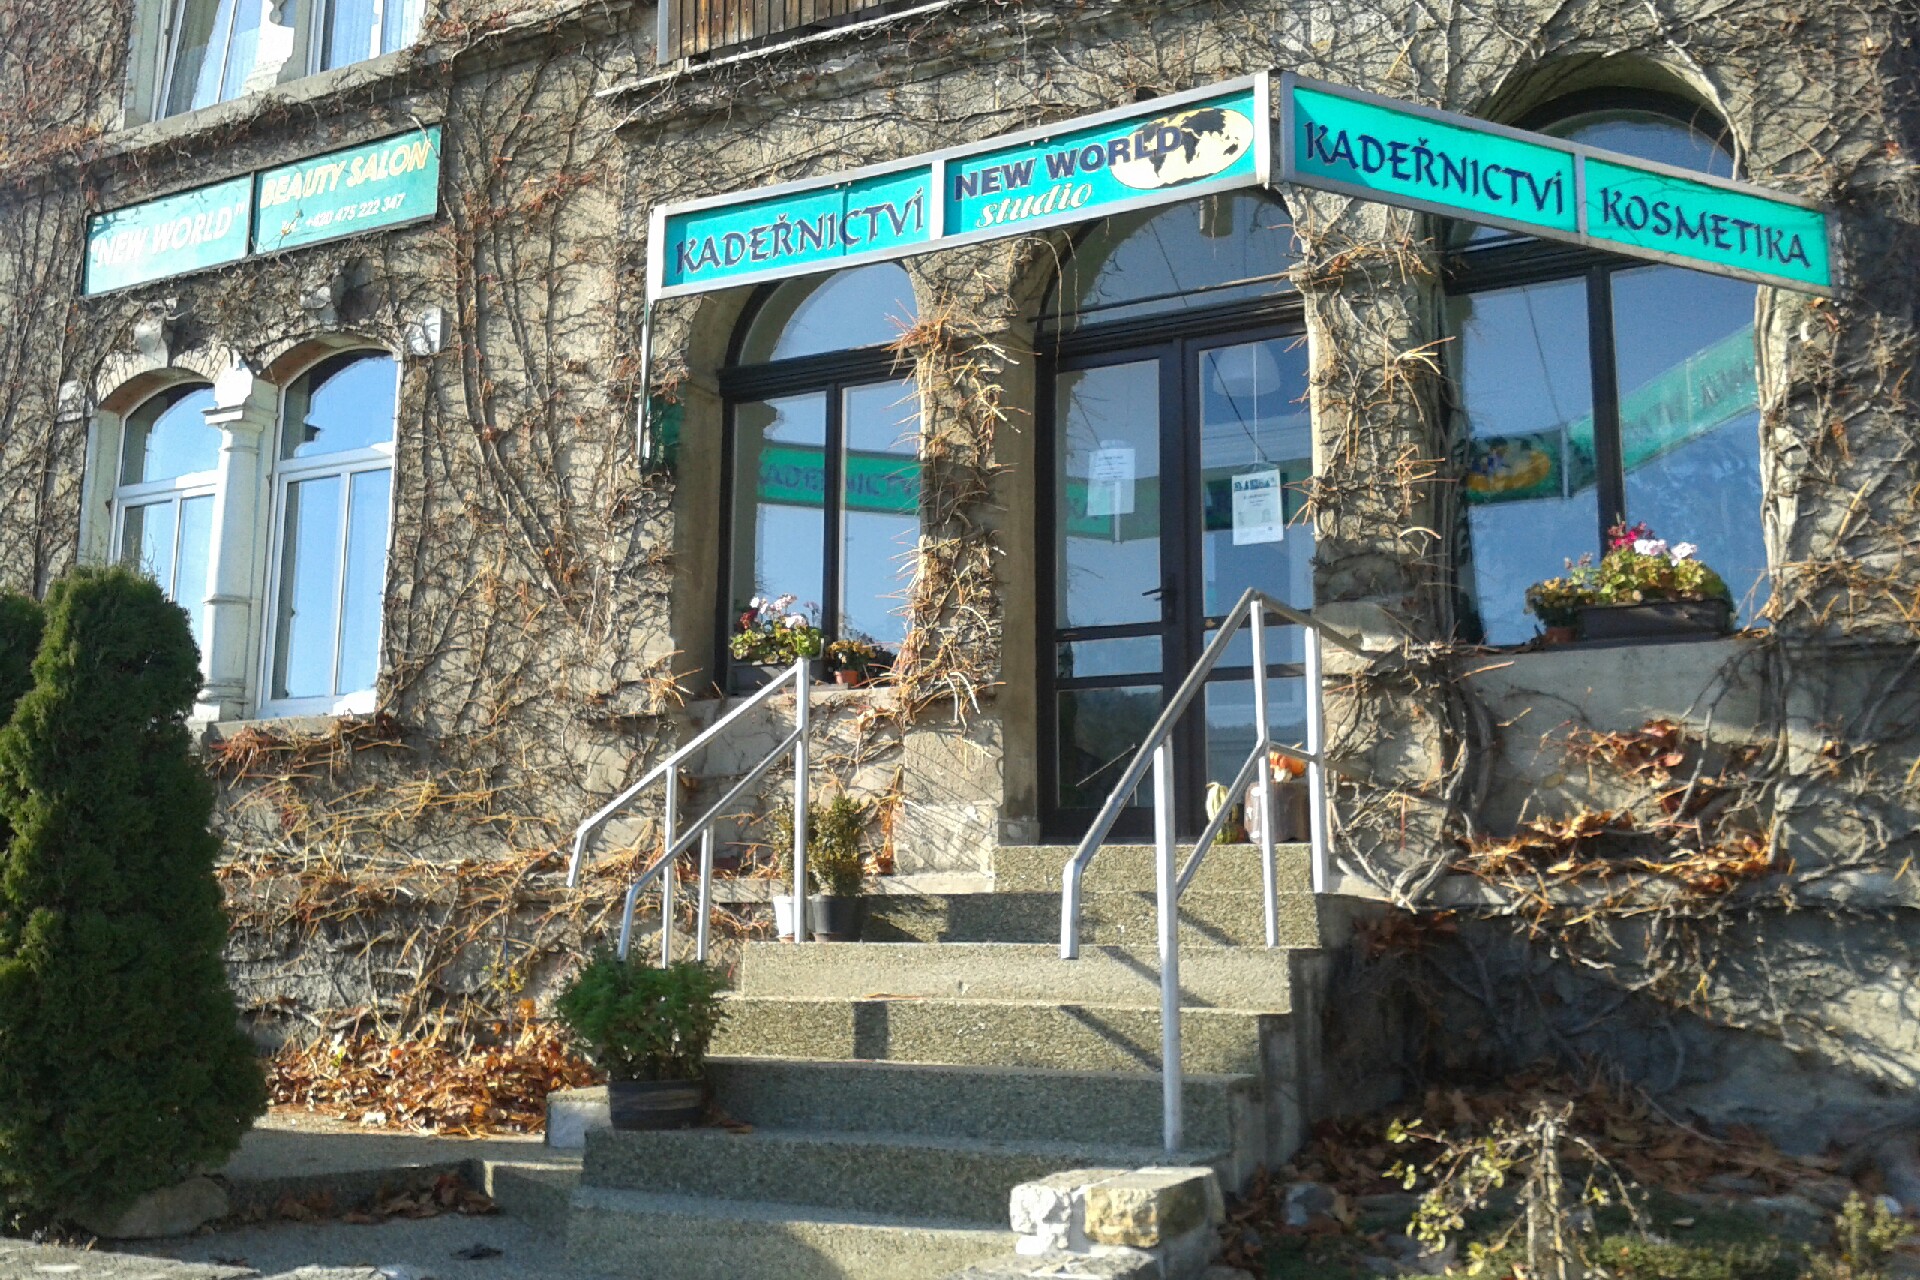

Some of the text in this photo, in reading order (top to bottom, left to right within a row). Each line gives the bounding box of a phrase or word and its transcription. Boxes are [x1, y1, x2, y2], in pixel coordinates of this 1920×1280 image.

[259, 139, 431, 209] BEAUTY SALON
[955, 125, 1183, 201] NEW WORLD
[1303, 120, 1564, 216] KADEŘNICTVÍ
[335, 203, 358, 222] 475
[357, 198, 381, 218] 222
[381, 192, 406, 213] 347
[676, 187, 925, 276] KADEŘNICTVÍ
[976, 182, 1093, 228] studio
[1599, 186, 1812, 269] KOSMETIKA
